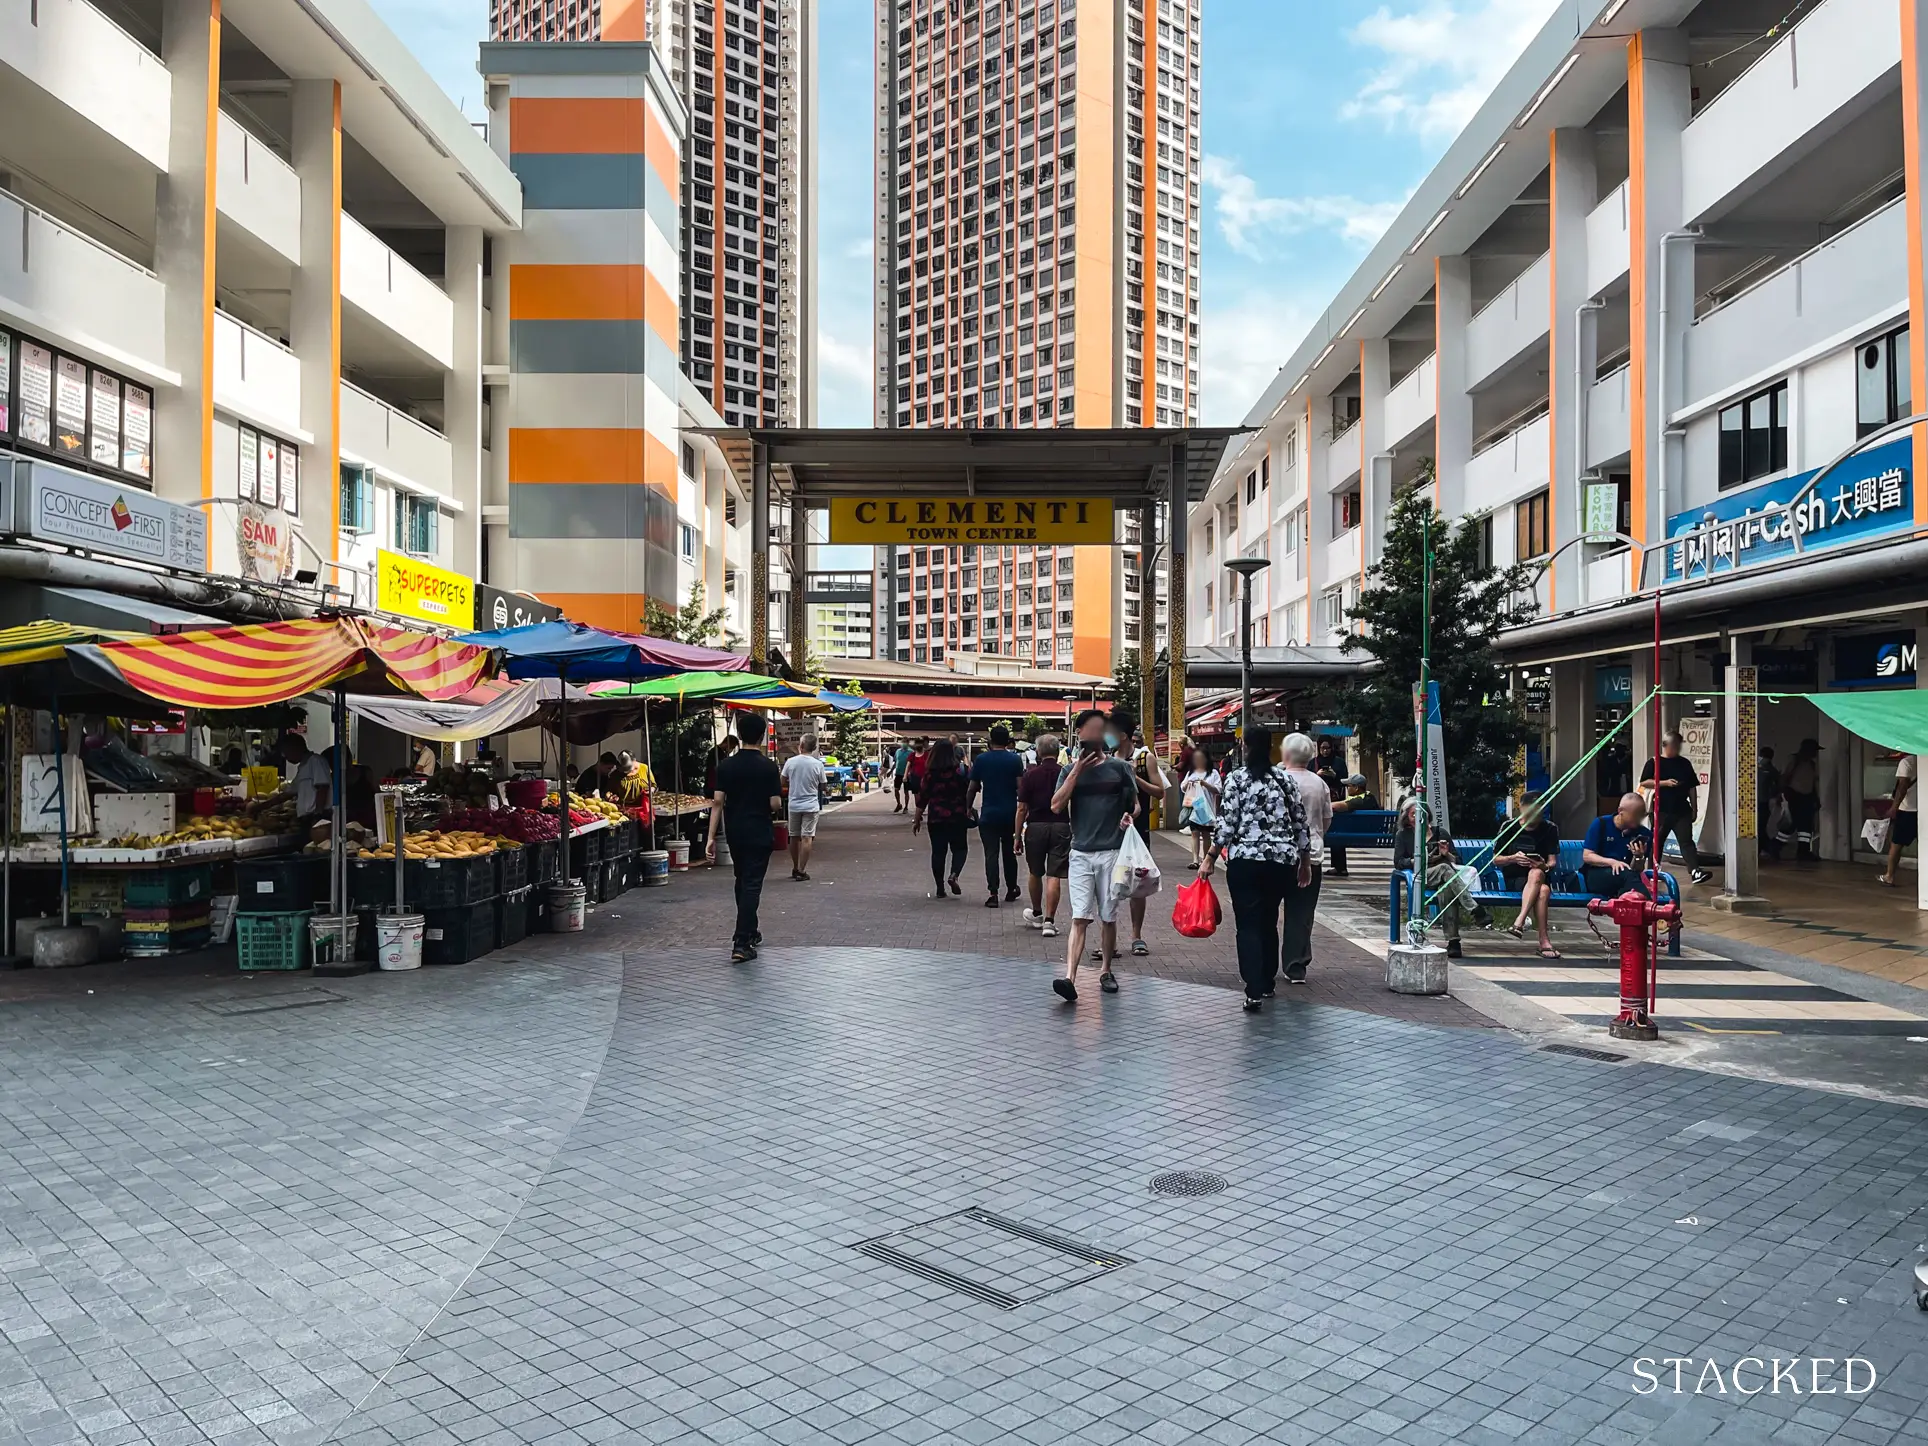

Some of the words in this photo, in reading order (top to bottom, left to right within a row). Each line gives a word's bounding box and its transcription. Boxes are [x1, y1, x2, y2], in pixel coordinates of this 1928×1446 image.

[66, 361, 78, 373] call
[1830, 466, 1903, 526] 大興當
[44, 491, 109, 525] CONCEPT
[133, 515, 162, 538] FIRST
[854, 501, 1089, 525] CLEMENTI
[44, 516, 62, 528] Your
[66, 520, 94, 537] Physics
[98, 528, 124, 543] Tuition
[127, 534, 162, 551] Specialist
[242, 517, 278, 547] SAM
[906, 527, 958, 540] TOWN
[965, 527, 1037, 540] CENTRE
[401, 568, 466, 605] SUPERPETS
[1525, 690, 1547, 700] eauty
[1430, 748, 1440, 777] JURONG
[1690, 745, 1711, 755] PRICE
[1432, 777, 1442, 810] HERITAGE
[1435, 811, 1444, 827] TRAI
